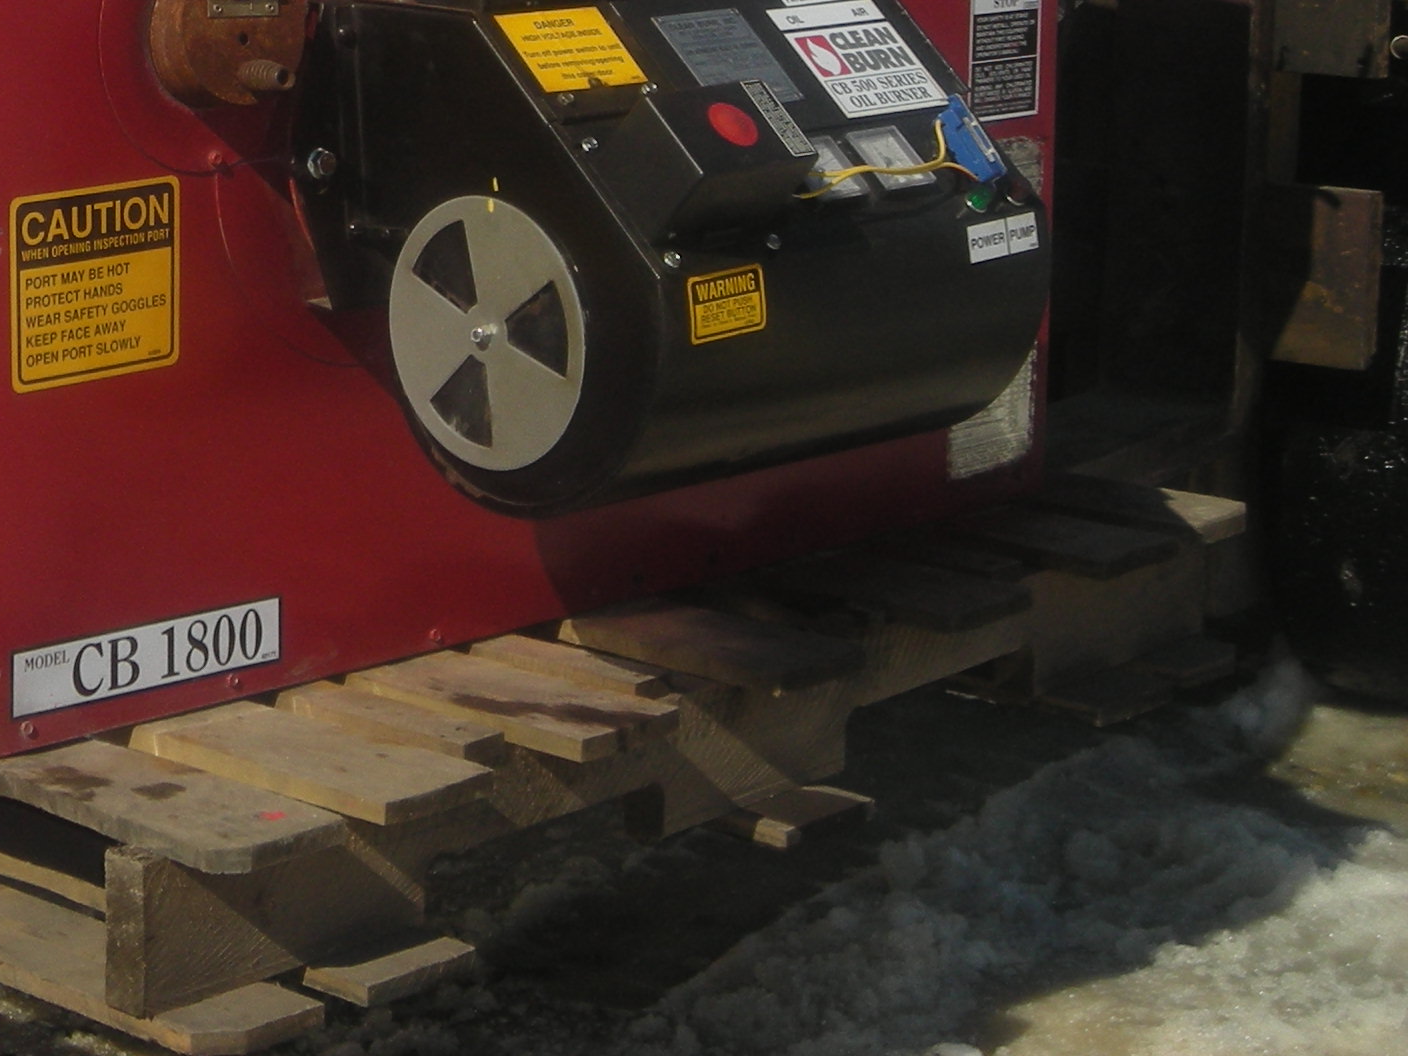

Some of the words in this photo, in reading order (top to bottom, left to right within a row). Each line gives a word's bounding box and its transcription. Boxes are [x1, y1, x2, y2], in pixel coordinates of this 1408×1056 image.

[533, 18, 575, 30] DANGER
[786, 15, 805, 24] OIL
[851, 7, 869, 16] AIR
[829, 27, 899, 50] CLEAN
[841, 46, 916, 73] BURN
[832, 80, 853, 95] CB
[851, 78, 879, 93] 500
[876, 71, 928, 89] SERIES
[849, 94, 878, 108] OIL
[874, 86, 933, 105] BURNER
[21, 193, 169, 246] CAUTION
[1009, 225, 1035, 240] PUMP
[21, 247, 49, 262] WHEN
[51, 241, 91, 258] OPENING
[93, 231, 145, 250] INSPECTION
[147, 228, 170, 242] PORT
[971, 232, 1005, 249] POWER
[25, 274, 58, 291] PORT
[61, 270, 85, 285] MAY
[89, 266, 104, 280] BE
[106, 262, 131, 277] HOT
[695, 272, 756, 302] WARNING
[25, 290, 80, 310] PROTECT
[83, 283, 123, 299] HANDS
[25, 311, 61, 329] WEAR
[64, 304, 109, 323] SAFETY
[111, 294, 167, 314] GOGGLES
[25, 331, 58, 348] KEEP
[61, 326, 91, 342] FACE
[94, 320, 126, 336] AWAY
[26, 350, 59, 367] OPEN
[62, 345, 94, 361] PORT
[96, 336, 141, 356] SLOWLY
[24, 650, 70, 672] MODEL
[72, 636, 140, 697] CB
[160, 608, 263, 679] 1800
